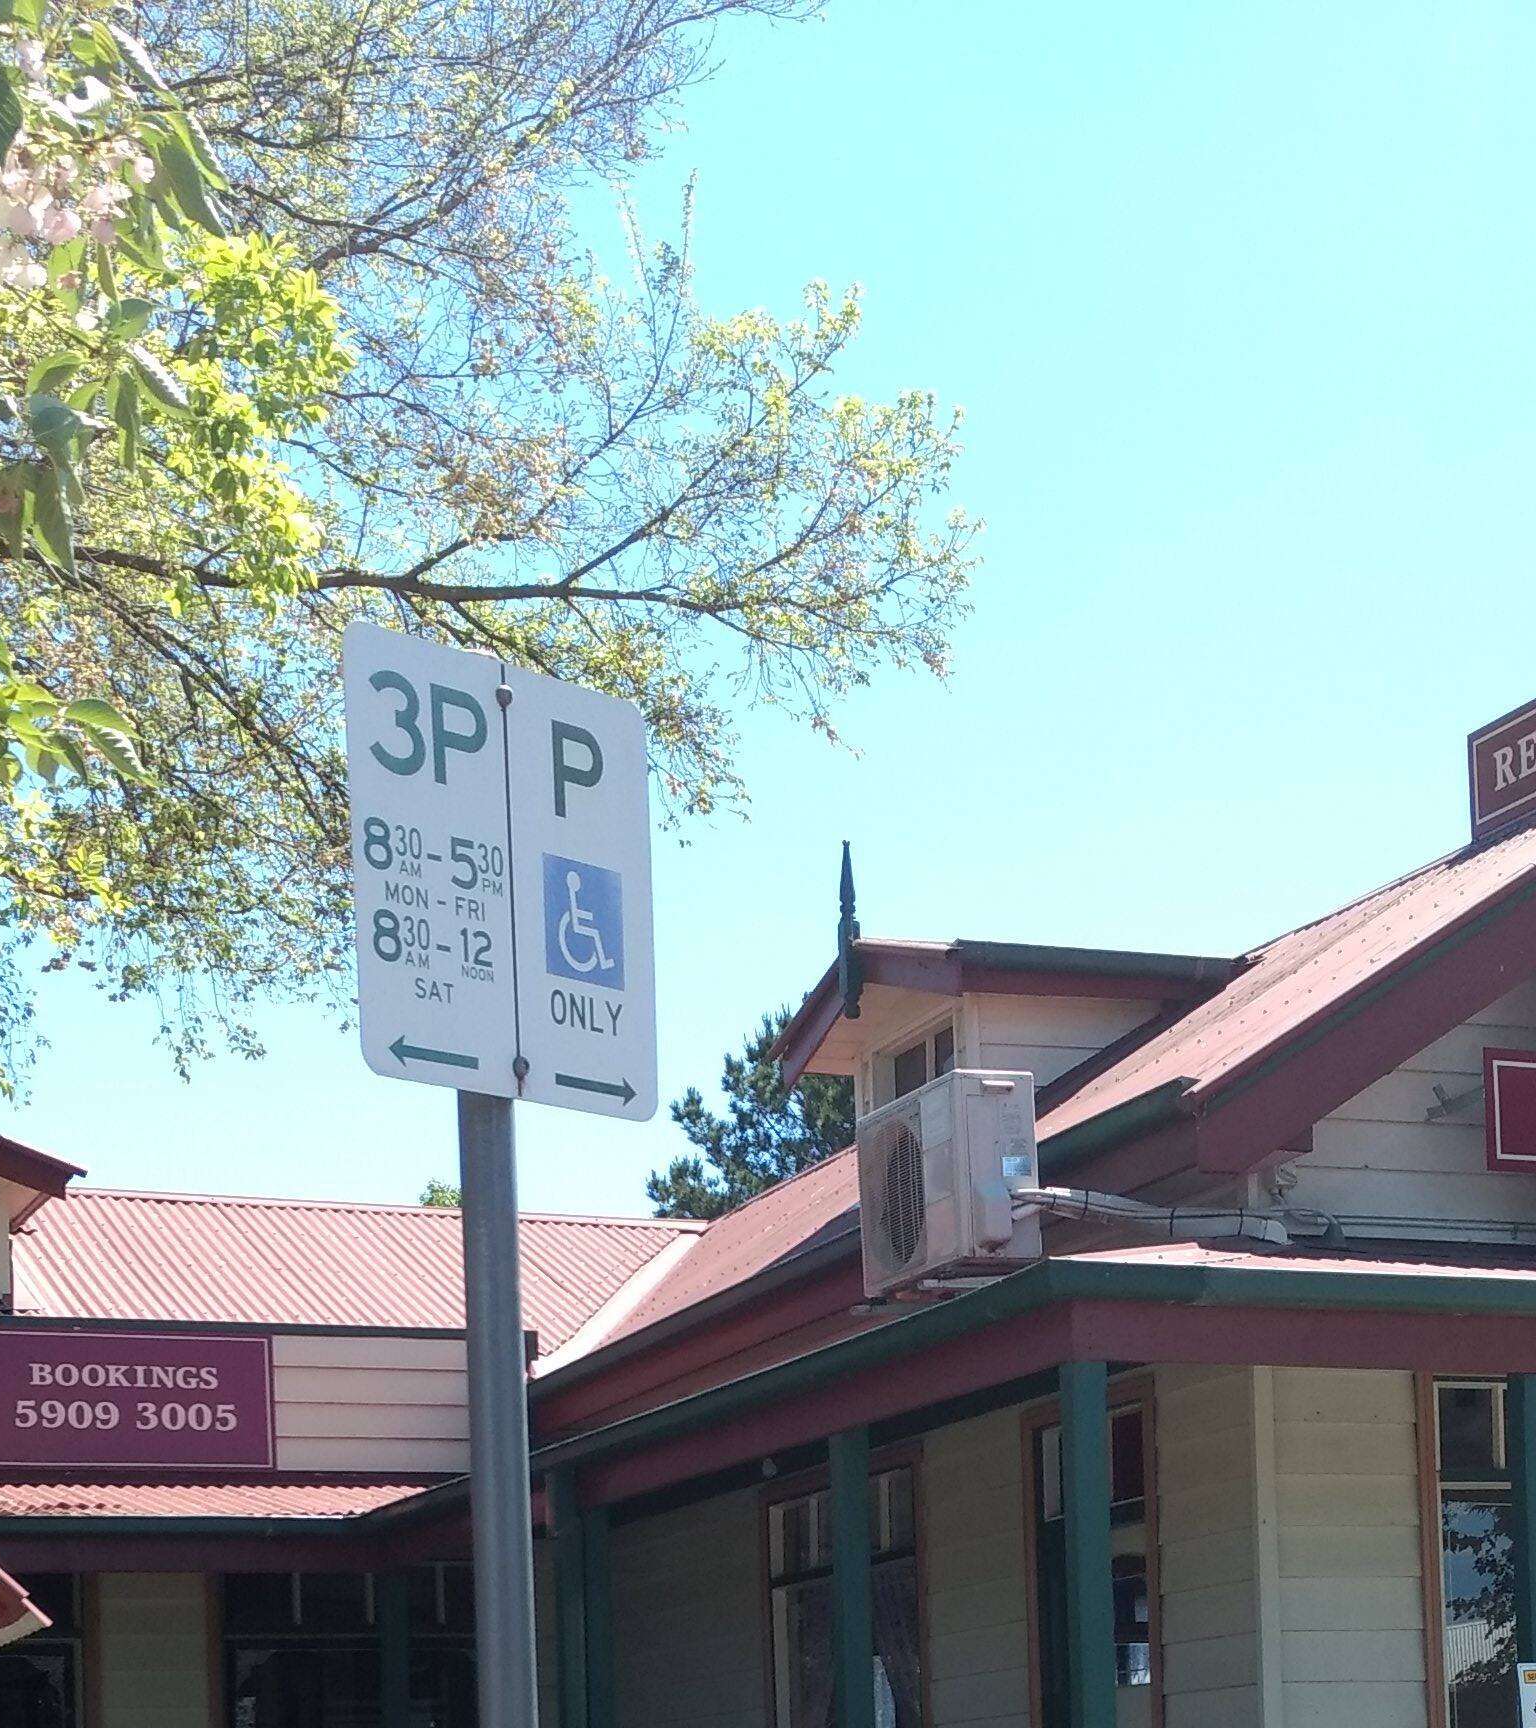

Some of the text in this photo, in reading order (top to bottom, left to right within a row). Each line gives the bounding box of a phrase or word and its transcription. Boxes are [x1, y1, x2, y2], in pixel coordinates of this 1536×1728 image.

[369, 670, 487, 785] 3P
[551, 718, 604, 818] P
[385, 880, 429, 910] MON
[455, 896, 485, 922] FRI
[415, 977, 454, 1004] SAT
[461, 965, 495, 983] NOON
[550, 989, 622, 1036] ONLY
[29, 1361, 219, 1390] BOOKINGS
[13, 1399, 238, 1433] 5909 3005
